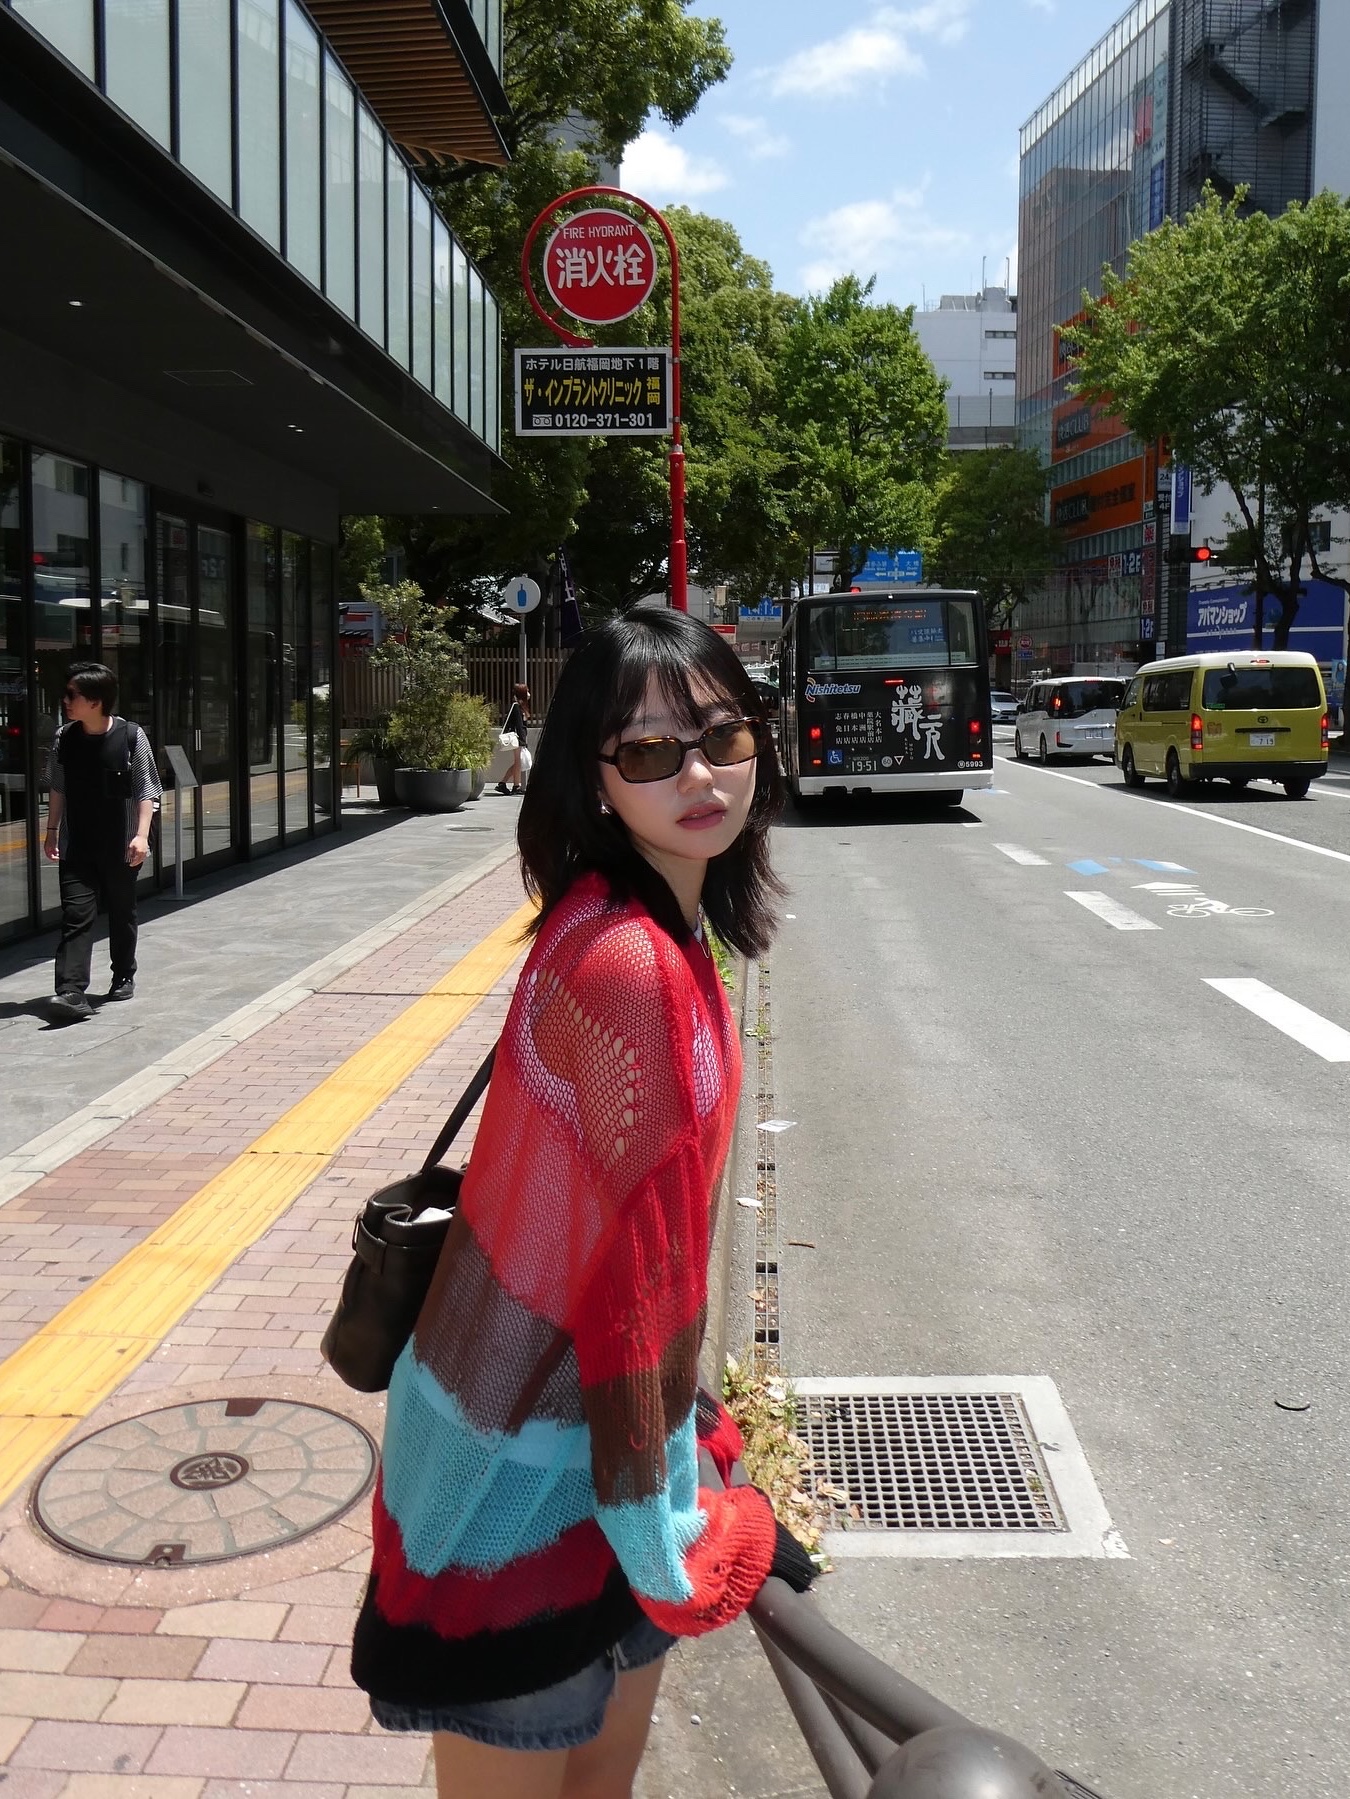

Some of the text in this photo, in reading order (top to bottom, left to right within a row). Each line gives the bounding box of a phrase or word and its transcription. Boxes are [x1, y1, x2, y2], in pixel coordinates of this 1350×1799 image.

[563, 225, 634, 239] FIRE HYDRANT
[556, 243, 646, 289] 消火栓
[526, 357, 659, 371] ホテル日航福岡地下1階
[524, 376, 661, 406] ザ・インプラントクリニック 福岡
[555, 413, 653, 427] 0120-371-301
[1198, 601, 1247, 627] アパマンショップ
[805, 684, 861, 696] Nishitetsu
